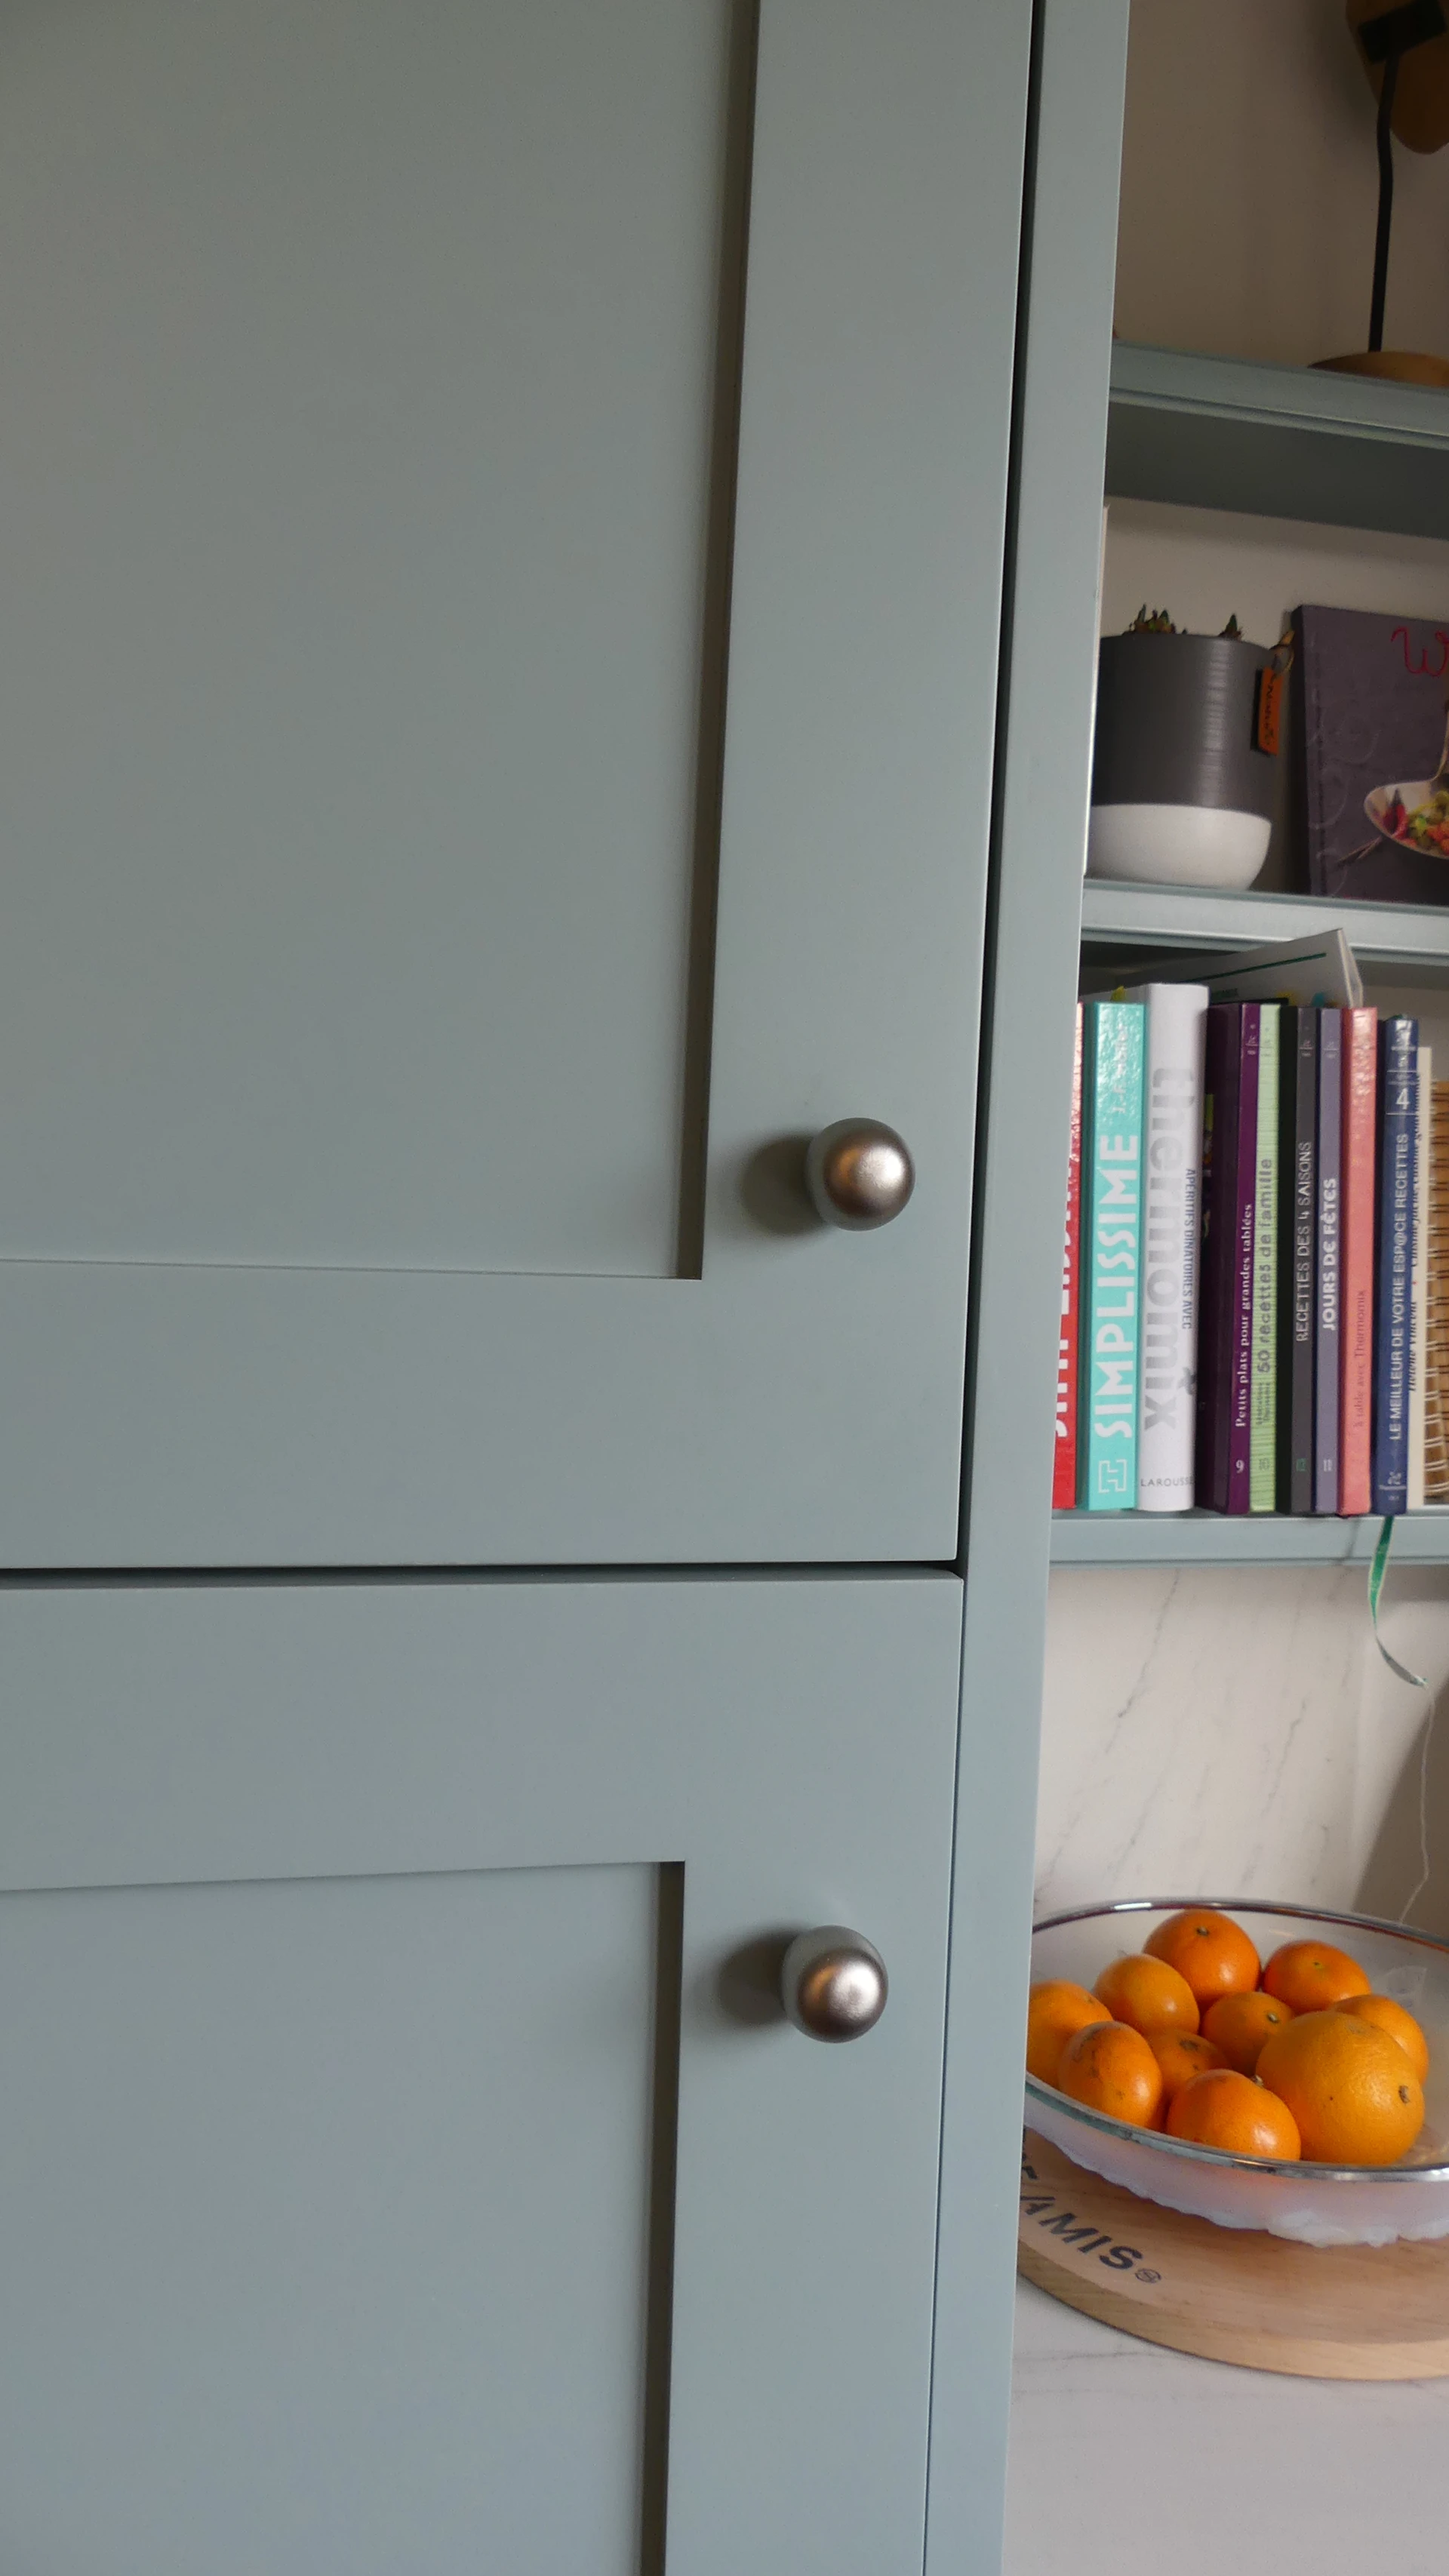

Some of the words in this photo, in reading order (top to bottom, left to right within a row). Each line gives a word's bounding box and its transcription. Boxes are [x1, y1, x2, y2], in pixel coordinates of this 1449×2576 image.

[1395, 1088, 1411, 1110] 4
[1259, 1159, 1273, 1227] famille
[1297, 1141, 1312, 1206] SAISONS
[1394, 1134, 1411, 1208] RECETTES
[1241, 1204, 1252, 1252] tablées
[1297, 1210, 1311, 1220] 4
[1321, 1178, 1337, 1236] FÊTES
[1144, 1067, 1196, 1431] thermomix
[1259, 1233, 1272, 1257] de
[1297, 1226, 1311, 1257] DES
[1322, 1241, 1337, 1266] DE
[1094, 1135, 1138, 1438] SIMPLISSIME
[1239, 1257, 1252, 1310] grandes
[1258, 1264, 1272, 1344] recettes
[1296, 1263, 1311, 1342] RECETTES
[1322, 1269, 1337, 1331] JOURS
[1392, 1276, 1407, 1325] VOTRE
[1181, 1300, 1193, 1330] AVEC
[1240, 1316, 1251, 1346] pour
[1354, 1290, 1367, 1358] Thermomix
[1391, 1328, 1404, 1347] DE
[1237, 1351, 1249, 1384] plats
[1257, 1350, 1271, 1374] 50
[1389, 1350, 1404, 1420] MEILLEUR
[1235, 1389, 1247, 1427] Petits
[1389, 1423, 1402, 1441] LE
[1235, 1460, 1245, 1473] 9
